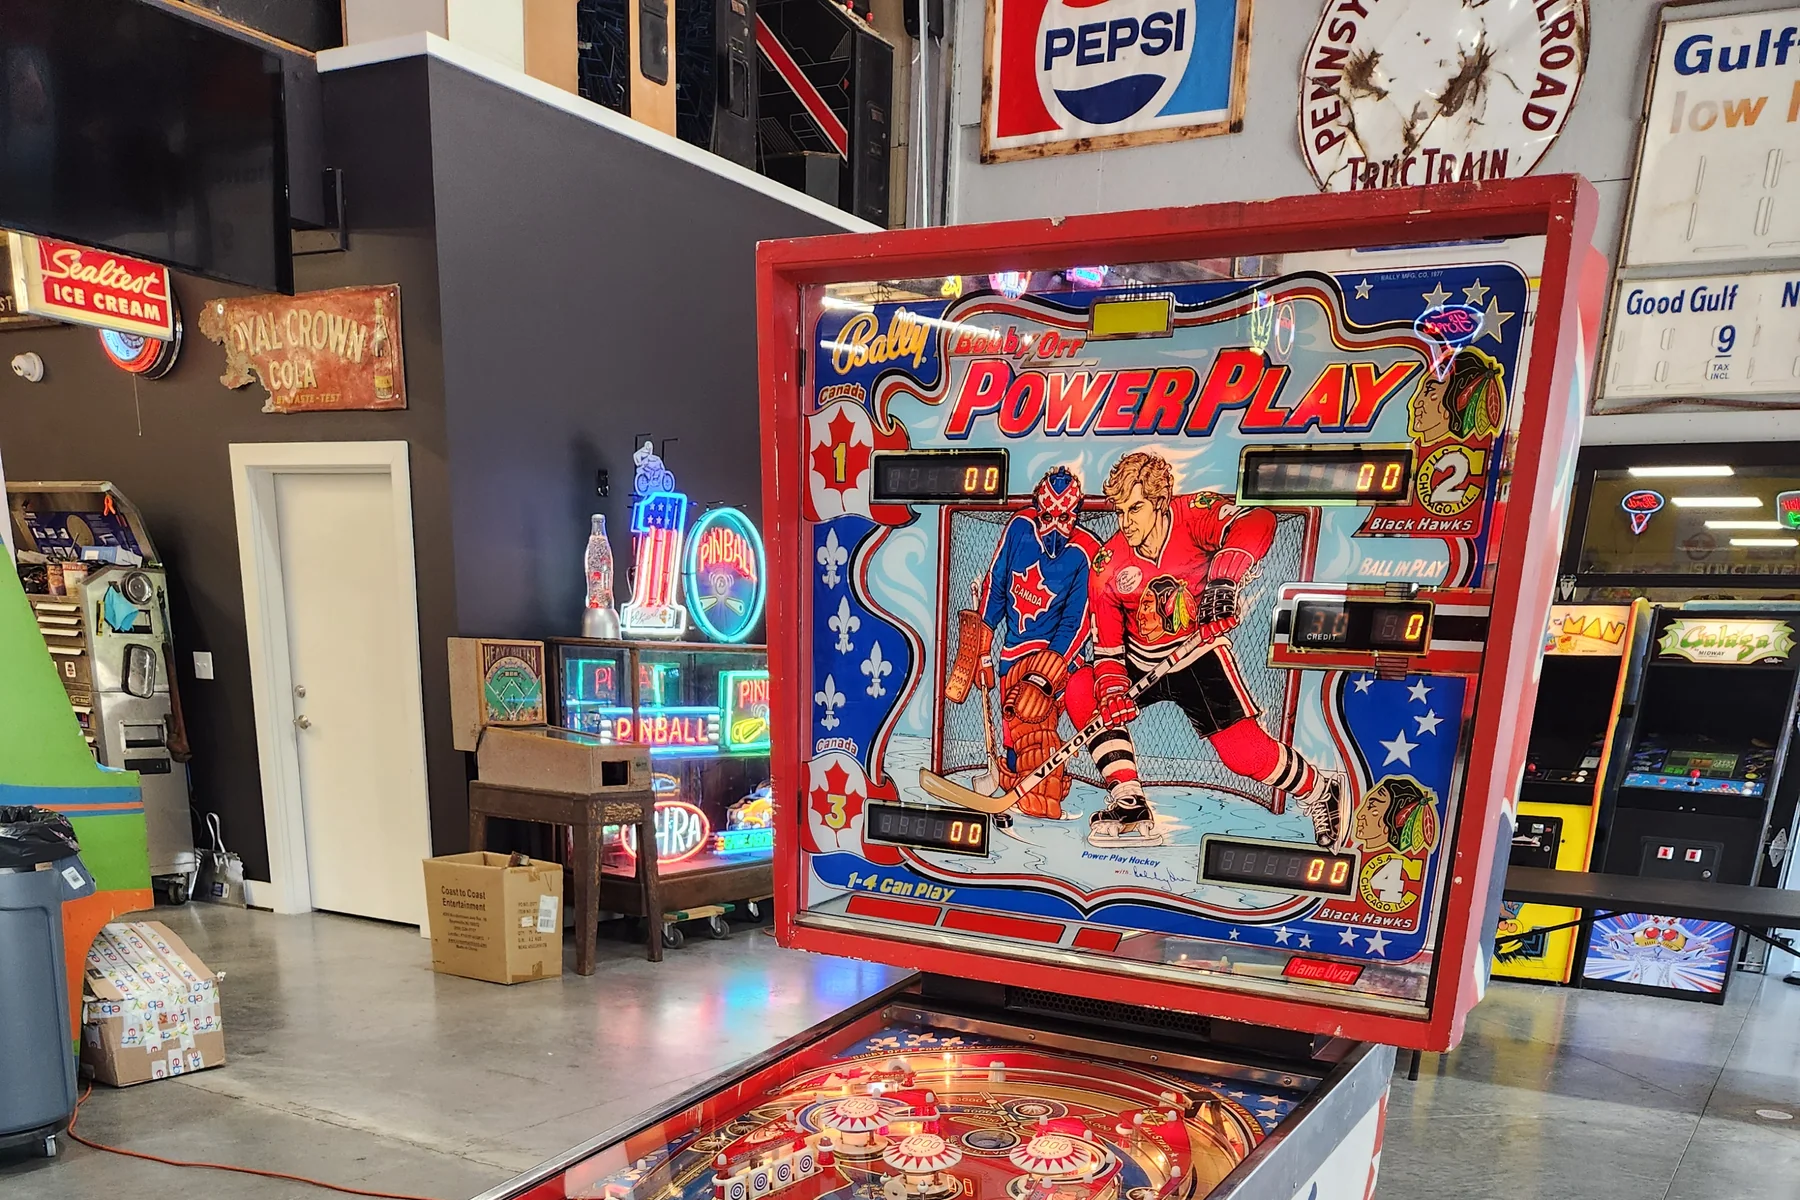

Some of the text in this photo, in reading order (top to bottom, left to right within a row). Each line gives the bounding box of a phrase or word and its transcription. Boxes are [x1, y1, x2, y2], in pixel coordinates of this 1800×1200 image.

[1044, 8, 1186, 71] PEPSI
[1674, 27, 1800, 76] Gulf
[1669, 90, 1769, 134] low
[1422, 148, 1509, 186] TRAIN
[48, 248, 166, 300] Sealtest
[53, 283, 161, 322] ICE CREAM
[1626, 289, 1686, 315] Good
[1690, 284, 1739, 313] Gulf
[286, 309, 367, 364] CROWN
[832, 306, 929, 375] Bally
[954, 326, 1086, 360] Bobby Orr
[1717, 325, 1736, 353] 9
[269, 360, 318, 390] COLA
[818, 384, 865, 405] Canada
[945, 348, 1423, 439] POWER PLAY
[833, 442, 846, 483] 1
[1430, 450, 1469, 503] 2
[965, 467, 998, 492] 00
[1357, 463, 1401, 491] 00
[1370, 517, 1473, 532] Black Hawks
[699, 525, 758, 583] PINBALL
[1359, 557, 1448, 578] BALL IN PLAY
[1014, 583, 1043, 606] CANADA
[1306, 632, 1338, 641] CREDIT
[1404, 612, 1425, 638] 0
[739, 679, 769, 709] PIN
[617, 716, 709, 744] PNBALL
[816, 738, 858, 756] Canada
[824, 794, 847, 829] 3
[950, 820, 982, 844] 00
[1081, 851, 1161, 867] Power Play Hockey
[1307, 858, 1349, 885] 00
[441, 886, 486, 900] Coast to Coast
[847, 871, 957, 903] 1-4 Can Play
[1370, 858, 1404, 904] 4
[442, 898, 486, 911] Entertainment
[1320, 906, 1413, 930] Black Hawks
[1289, 957, 1357, 982] Game Over
[843, 1099, 876, 1111] 1000
[907, 1136, 941, 1150] 1000
[1034, 1138, 1069, 1151] 1000
